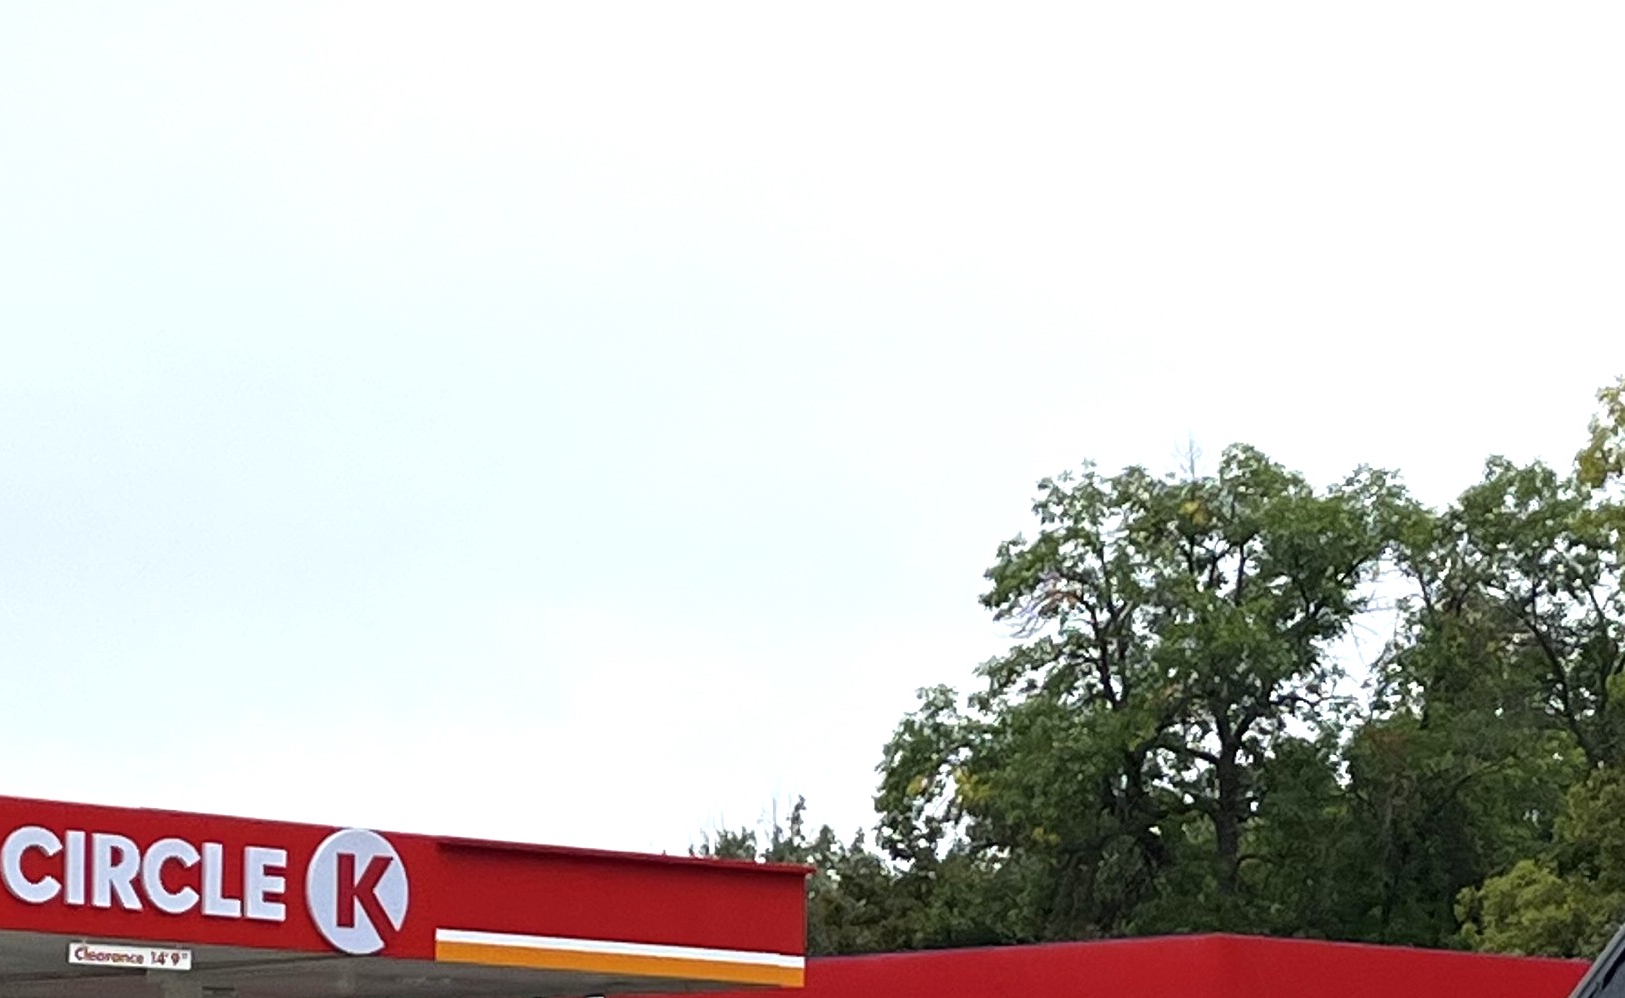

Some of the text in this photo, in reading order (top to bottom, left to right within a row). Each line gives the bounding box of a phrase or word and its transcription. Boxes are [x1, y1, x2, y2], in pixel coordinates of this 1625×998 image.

[0, 825, 402, 948] CIRCLE K
[75, 947, 144, 965] Clearance
